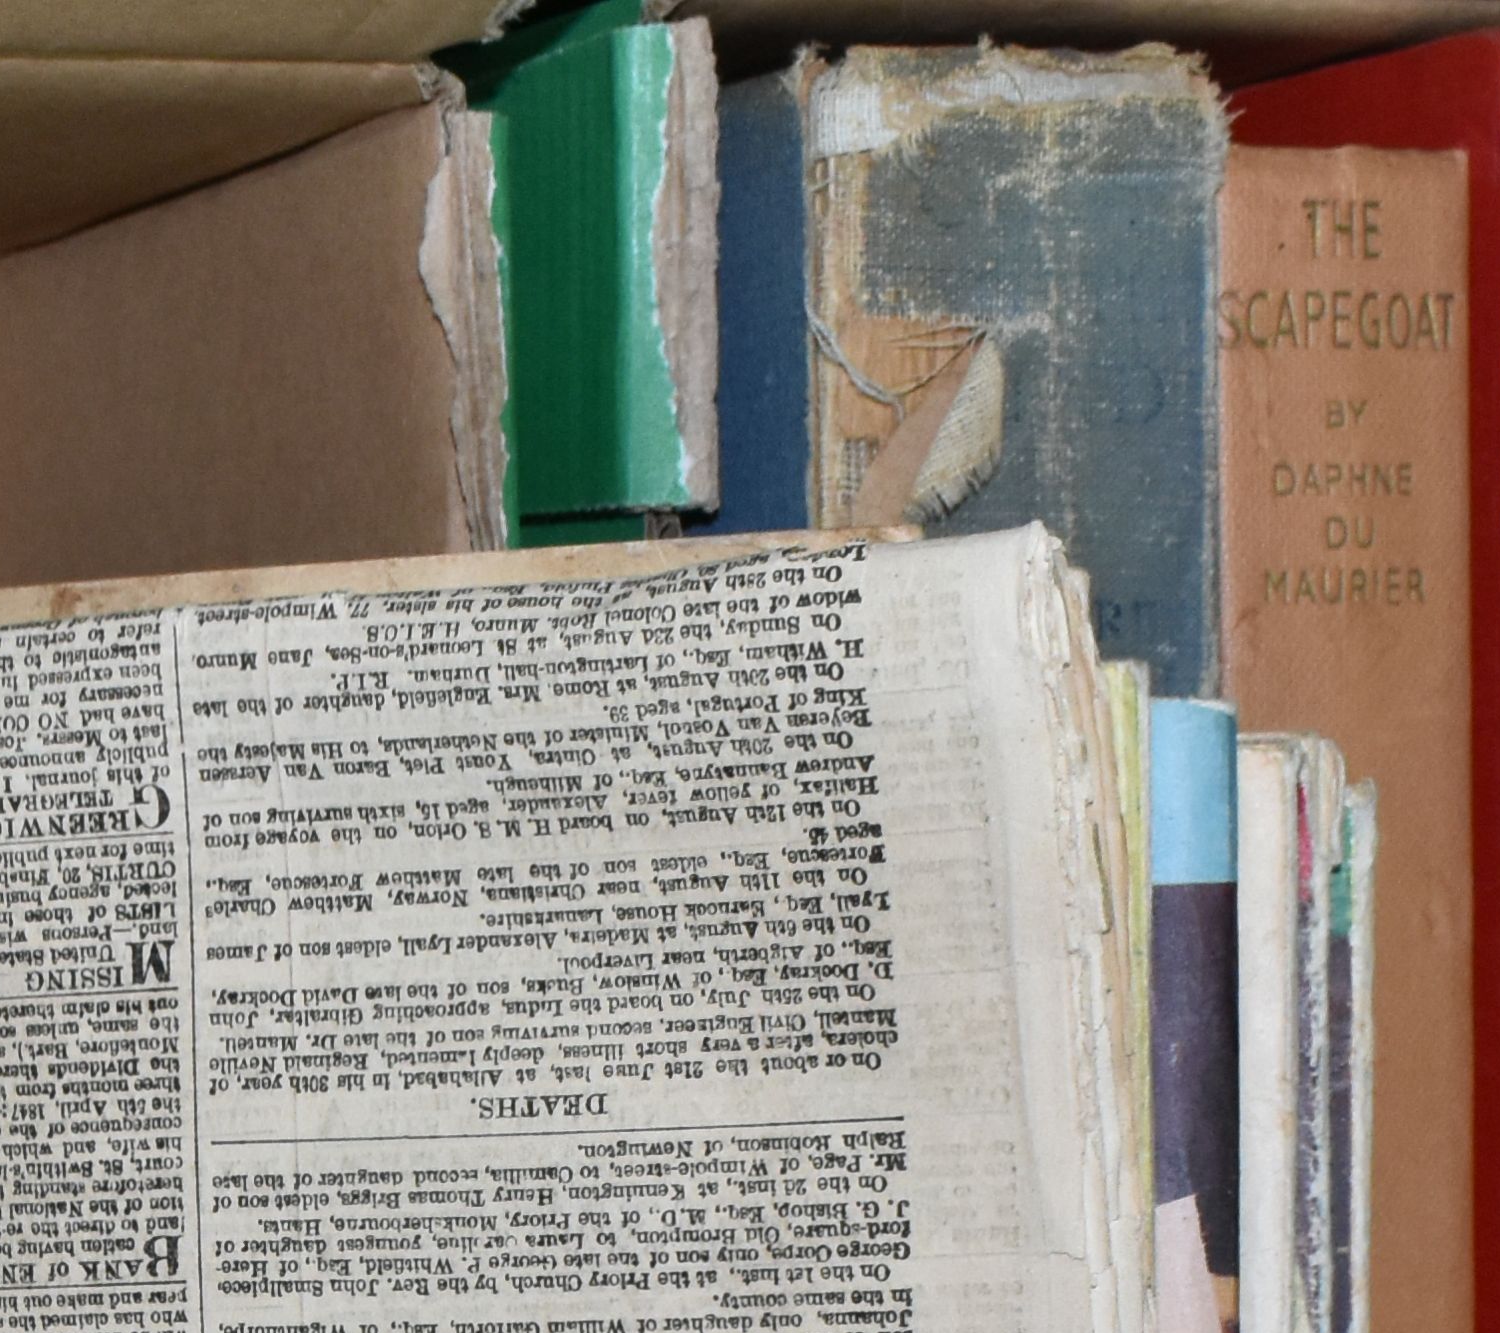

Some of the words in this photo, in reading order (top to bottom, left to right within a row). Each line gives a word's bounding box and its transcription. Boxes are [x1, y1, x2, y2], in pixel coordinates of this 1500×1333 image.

[1302, 199, 1382, 258] THE
[1217, 290, 1454, 350] SCAPEGOAT
[1326, 401, 1366, 427] BY
[1273, 463, 1412, 495] DAPHNE
[1326, 516, 1375, 548] DU
[1264, 569, 1425, 604] MAURIER
[687, 692, 780, 715] Portugal,
[788, 693, 808, 709] of
[813, 687, 866, 707] King
[603, 704, 629, 722] 39.
[635, 700, 680, 718] aged
[795, 756, 874, 774] Andrew
[593, 773, 612, 789] of
[833, 822, 882, 841] aged
[661, 950, 705, 966] near
[814, 943, 834, 960] of
[841, 939, 893, 958] Esq.,
[24, 941, 174, 991] MISSING
[471, 1091, 608, 1118] DEATHS.
[731, 1135, 831, 1154] Robinson,
[843, 1130, 905, 1151] Ralph
[712, 1291, 787, 1309] county.
[794, 1292, 845, 1307] same
[851, 1289, 883, 1306] the
[891, 1288, 912, 1305] in
